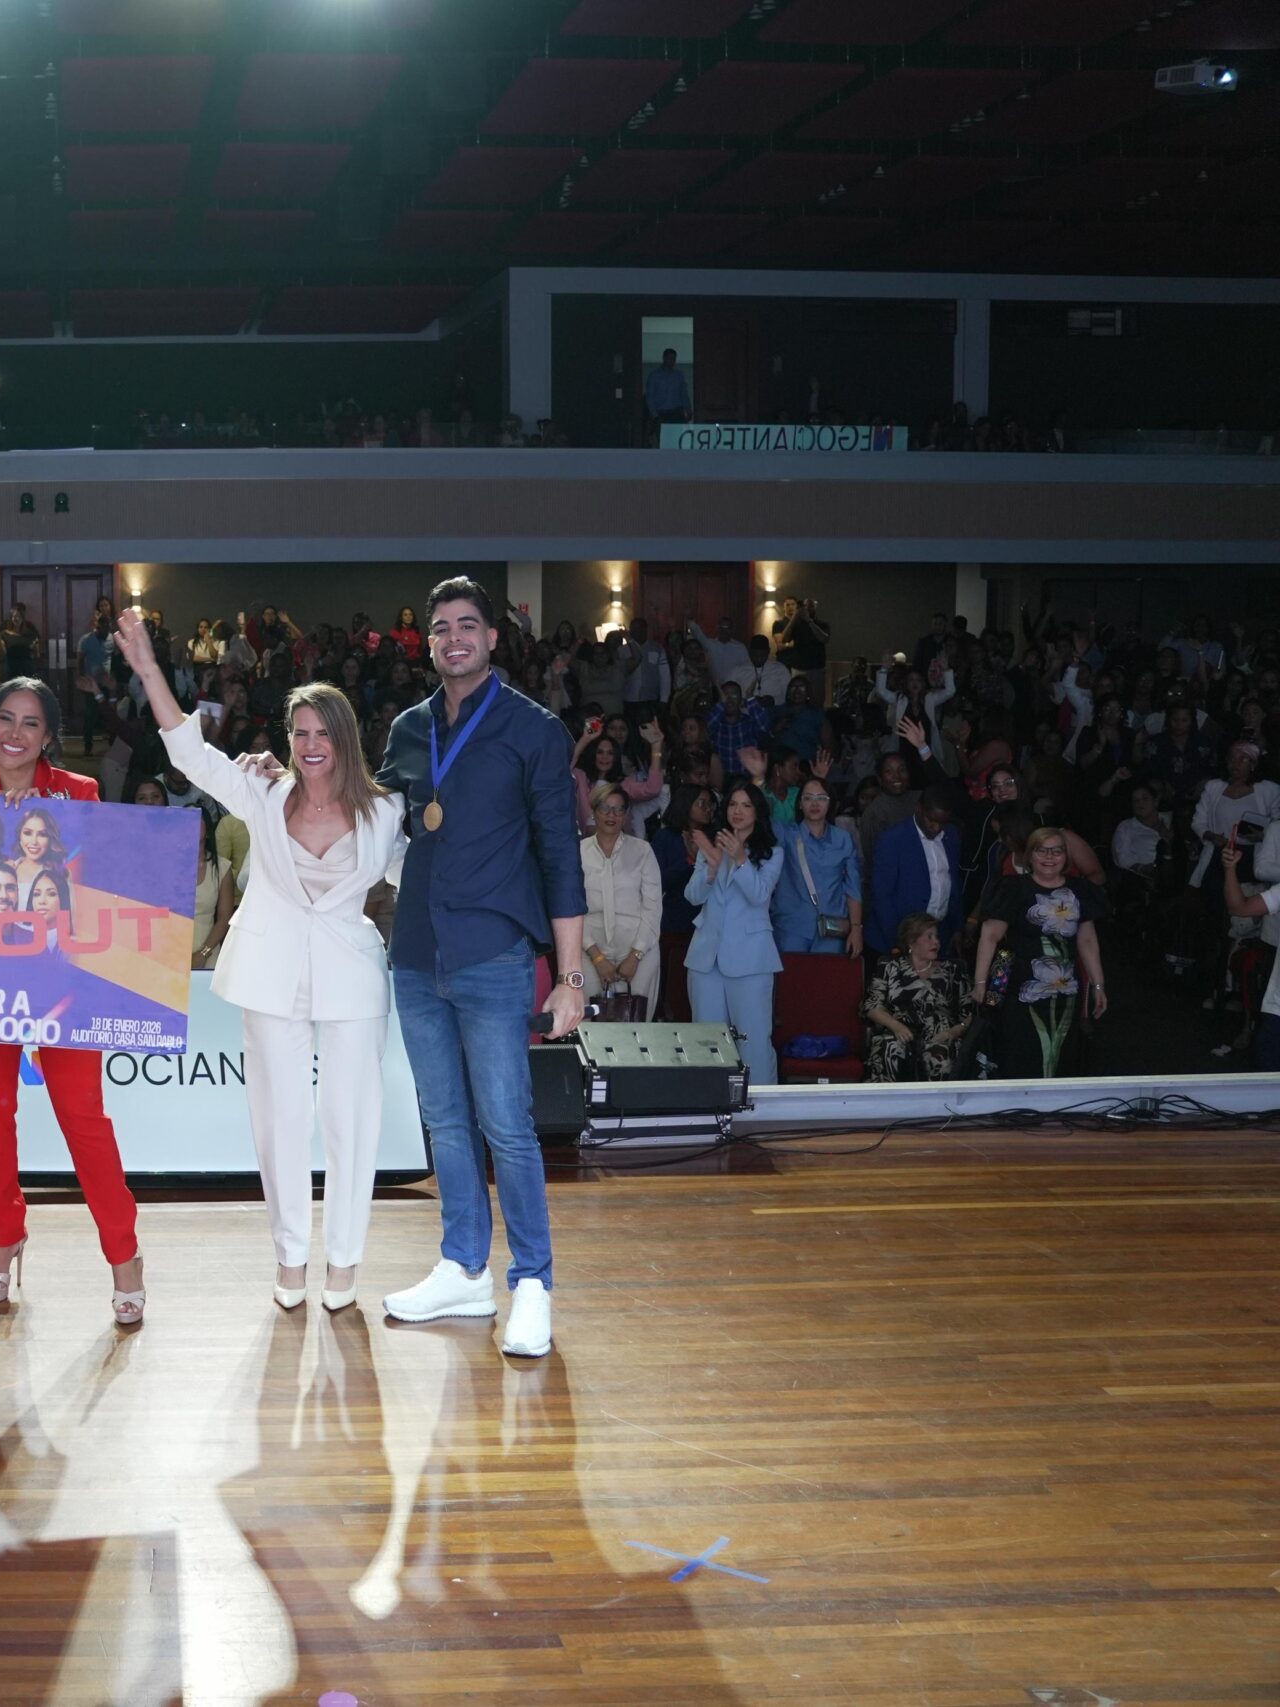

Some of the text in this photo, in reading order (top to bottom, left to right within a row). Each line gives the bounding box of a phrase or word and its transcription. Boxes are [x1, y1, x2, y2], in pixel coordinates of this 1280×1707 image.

[11, 990, 31, 1016] A
[91, 1017, 162, 1034] 18 DE ENERO 2026
[71, 1029, 113, 1044] AUDITORIO
[114, 1032, 136, 1046] CASA
[137, 1033, 155, 1047] SAN
